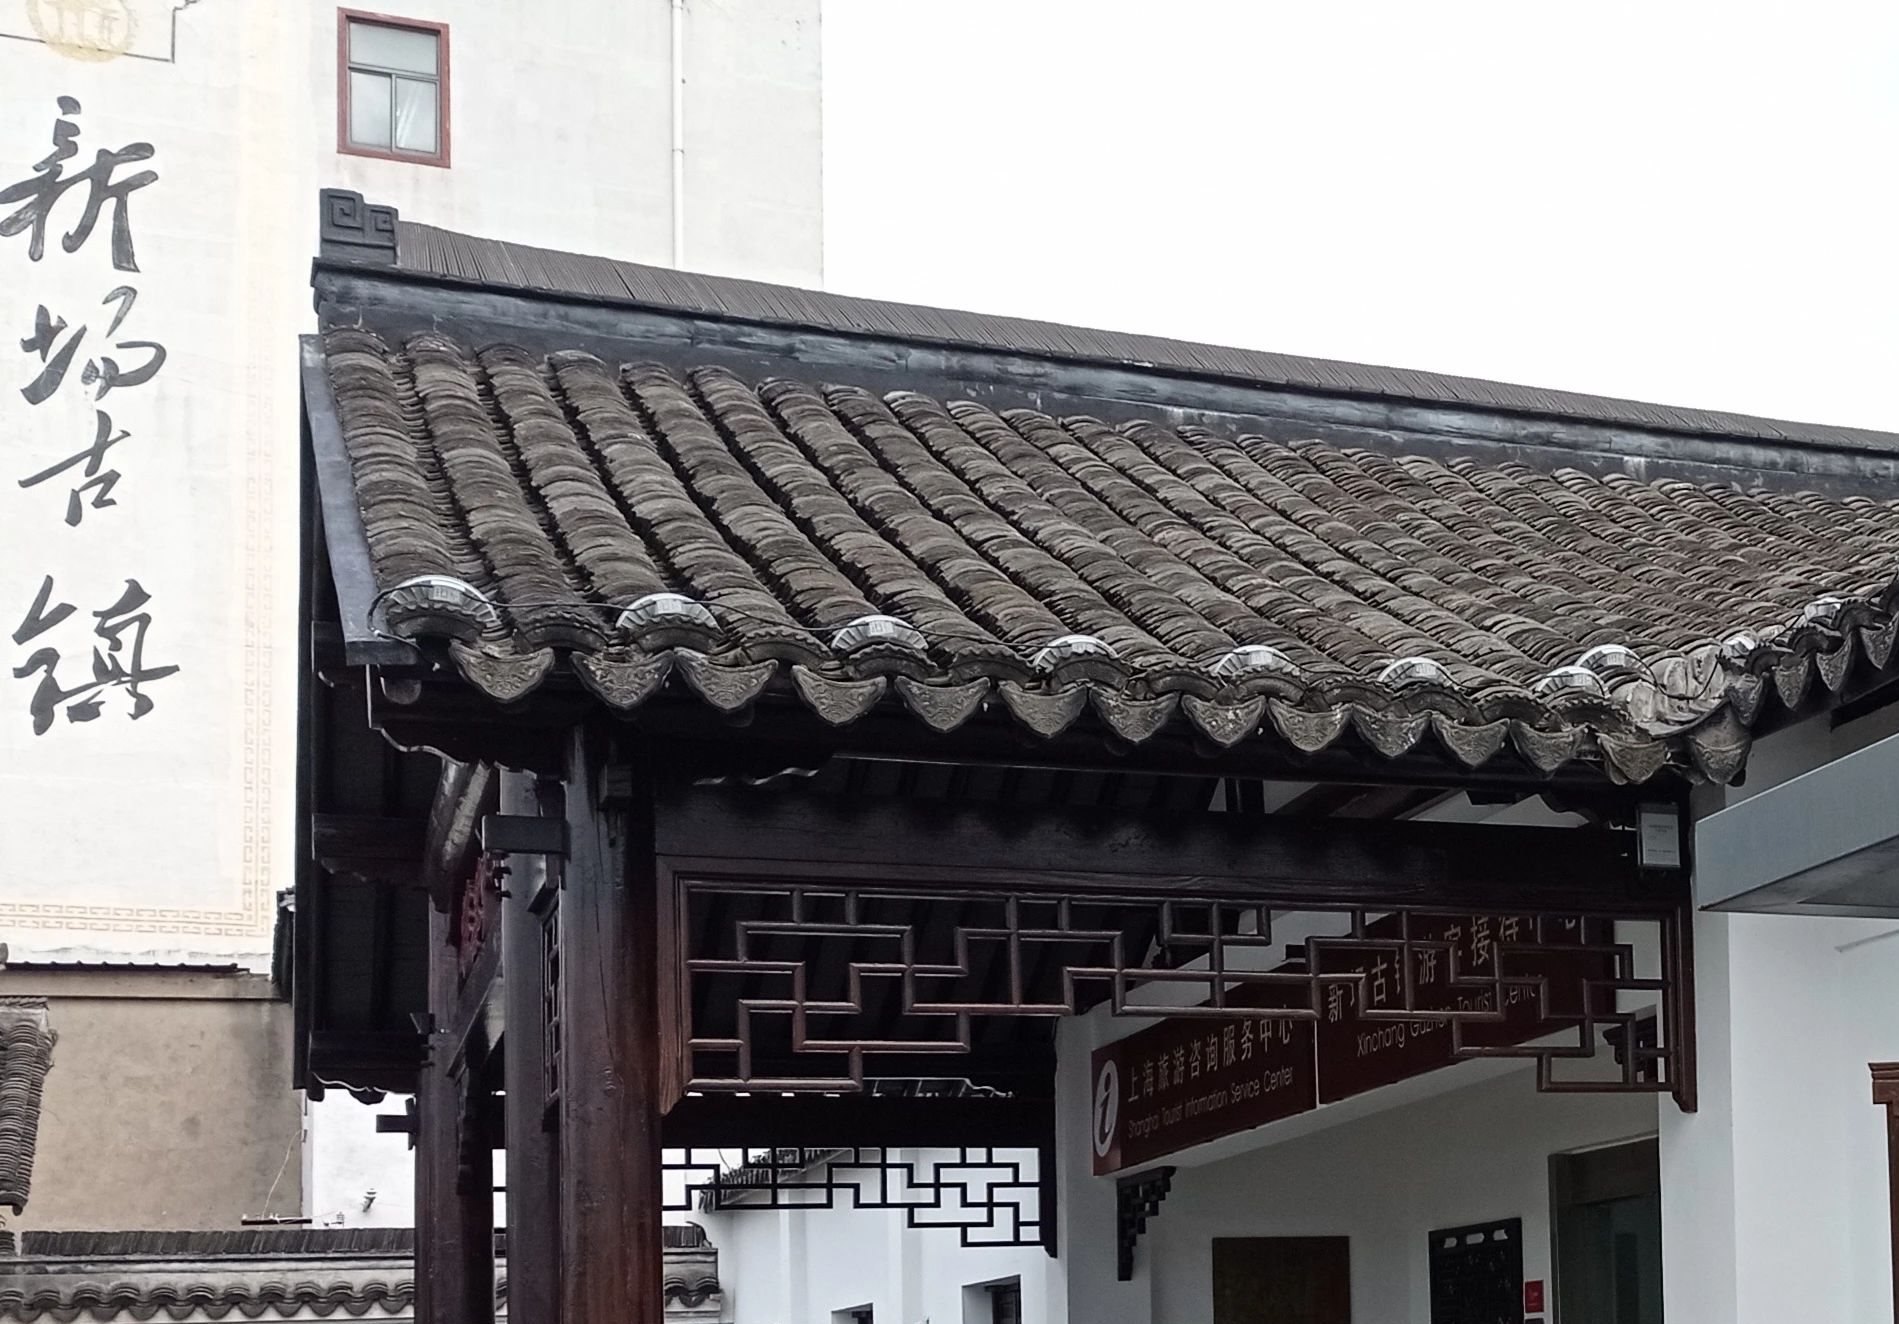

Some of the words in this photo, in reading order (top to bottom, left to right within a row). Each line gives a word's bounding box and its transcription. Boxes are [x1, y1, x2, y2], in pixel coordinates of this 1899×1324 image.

[1126, 1013, 1295, 1104] 上海旅游咨询服务中心
[1356, 1021, 1407, 1057] Xinchang
[1230, 1077, 1260, 1104] Service
[1263, 1065, 1295, 1092] Center
